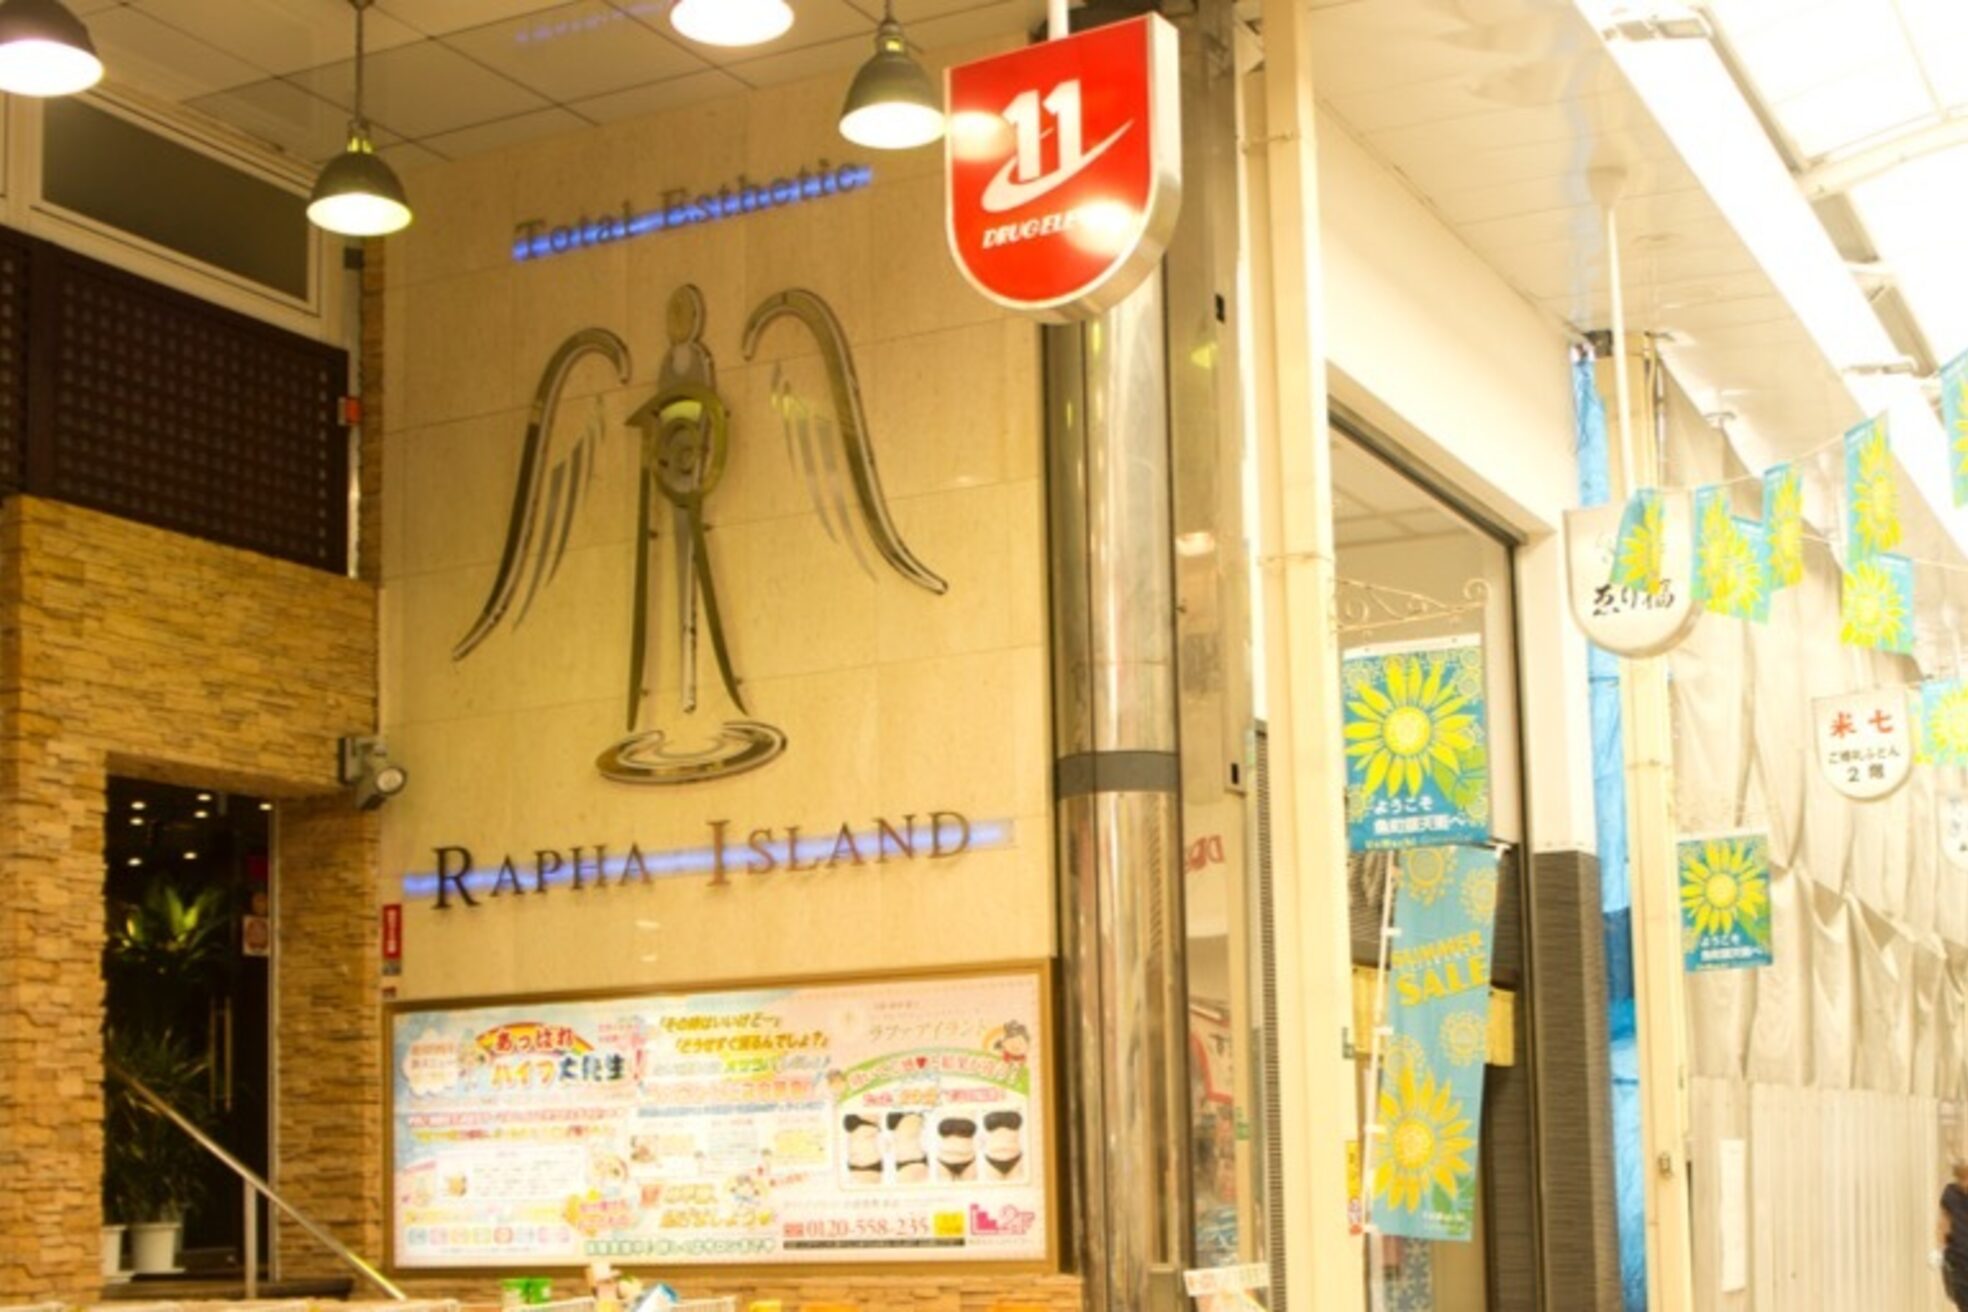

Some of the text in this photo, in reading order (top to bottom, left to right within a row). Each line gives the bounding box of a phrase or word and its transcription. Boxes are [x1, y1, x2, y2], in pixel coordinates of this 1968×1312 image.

[1001, 78, 1083, 183] 11
[514, 158, 861, 258] Total Esthetic
[1373, 795, 1433, 815] ようこそ
[431, 811, 971, 910] RAPHA ISLAND
[1391, 929, 1483, 968] SUMMER
[1395, 953, 1488, 1007] SALE
[805, 1213, 930, 1238] 0120-558-235
